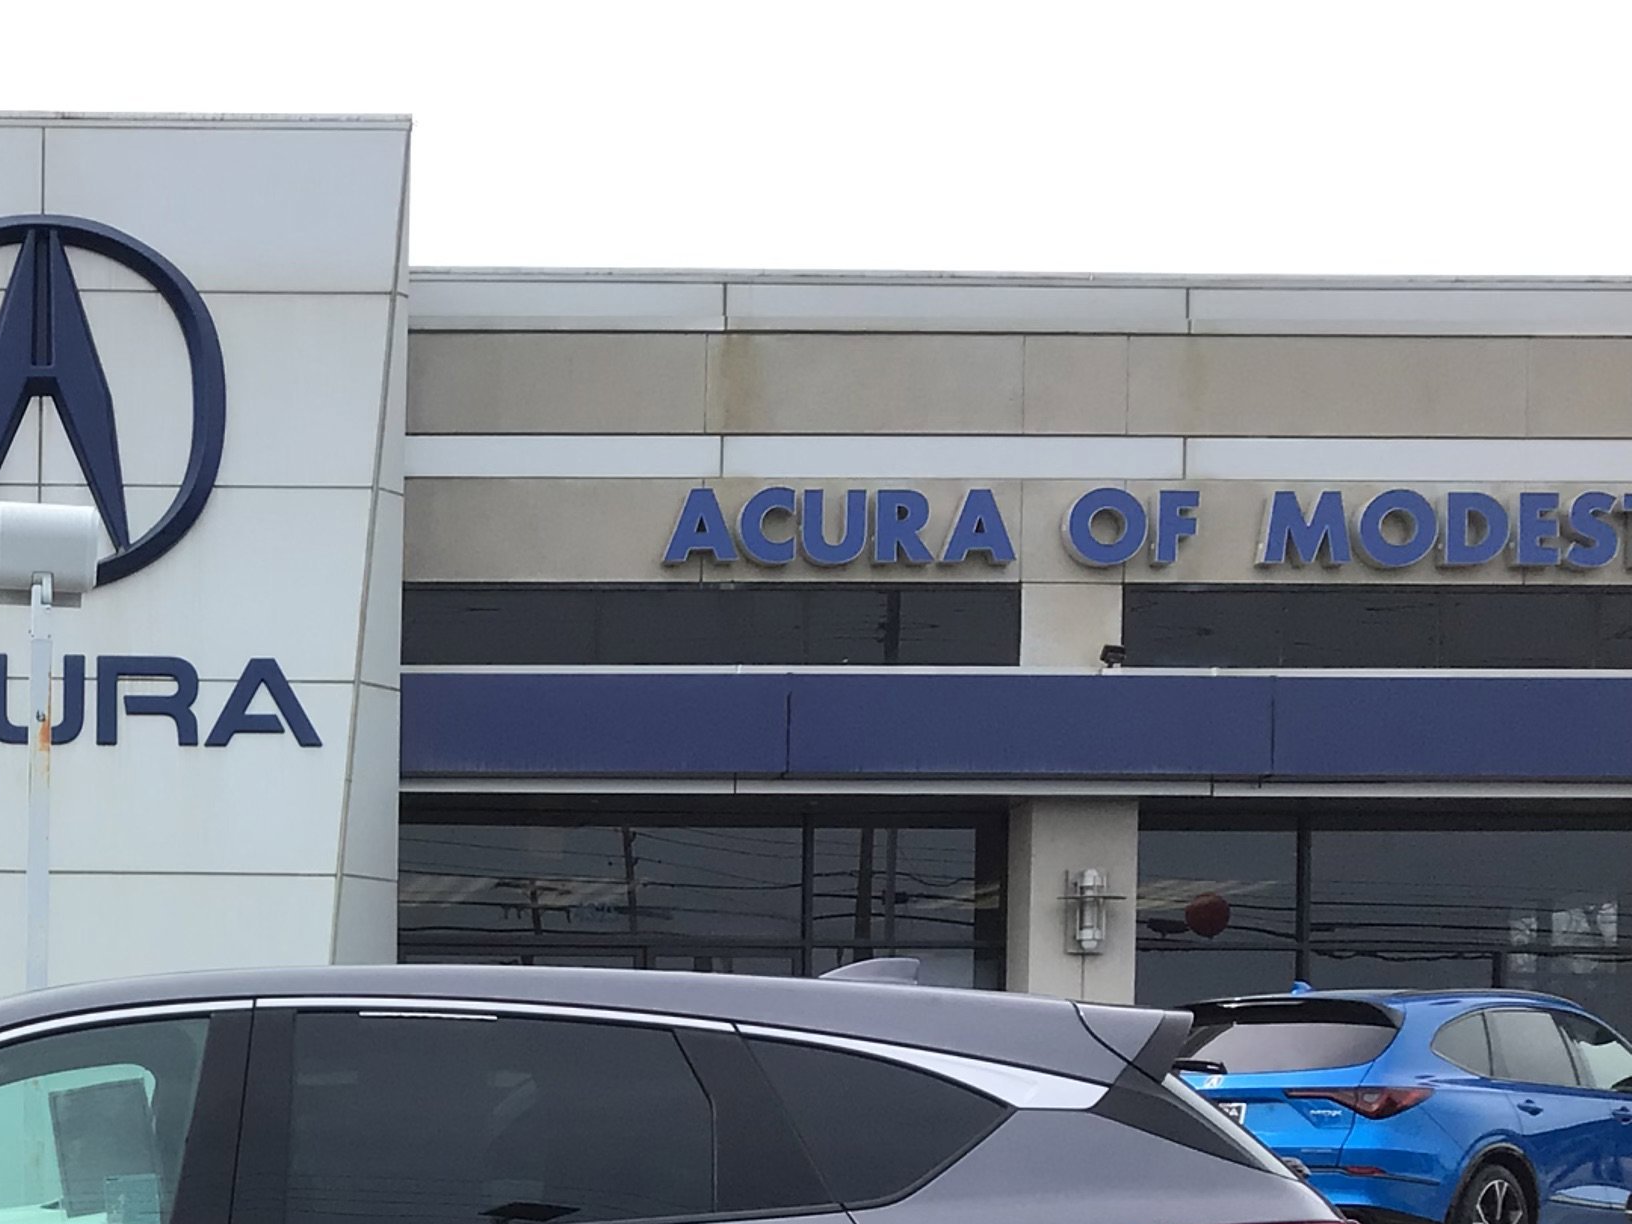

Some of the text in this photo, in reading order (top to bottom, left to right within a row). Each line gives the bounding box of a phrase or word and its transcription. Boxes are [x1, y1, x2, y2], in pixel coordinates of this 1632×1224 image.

[666, 486, 1632, 567] ACURA OF MODES
